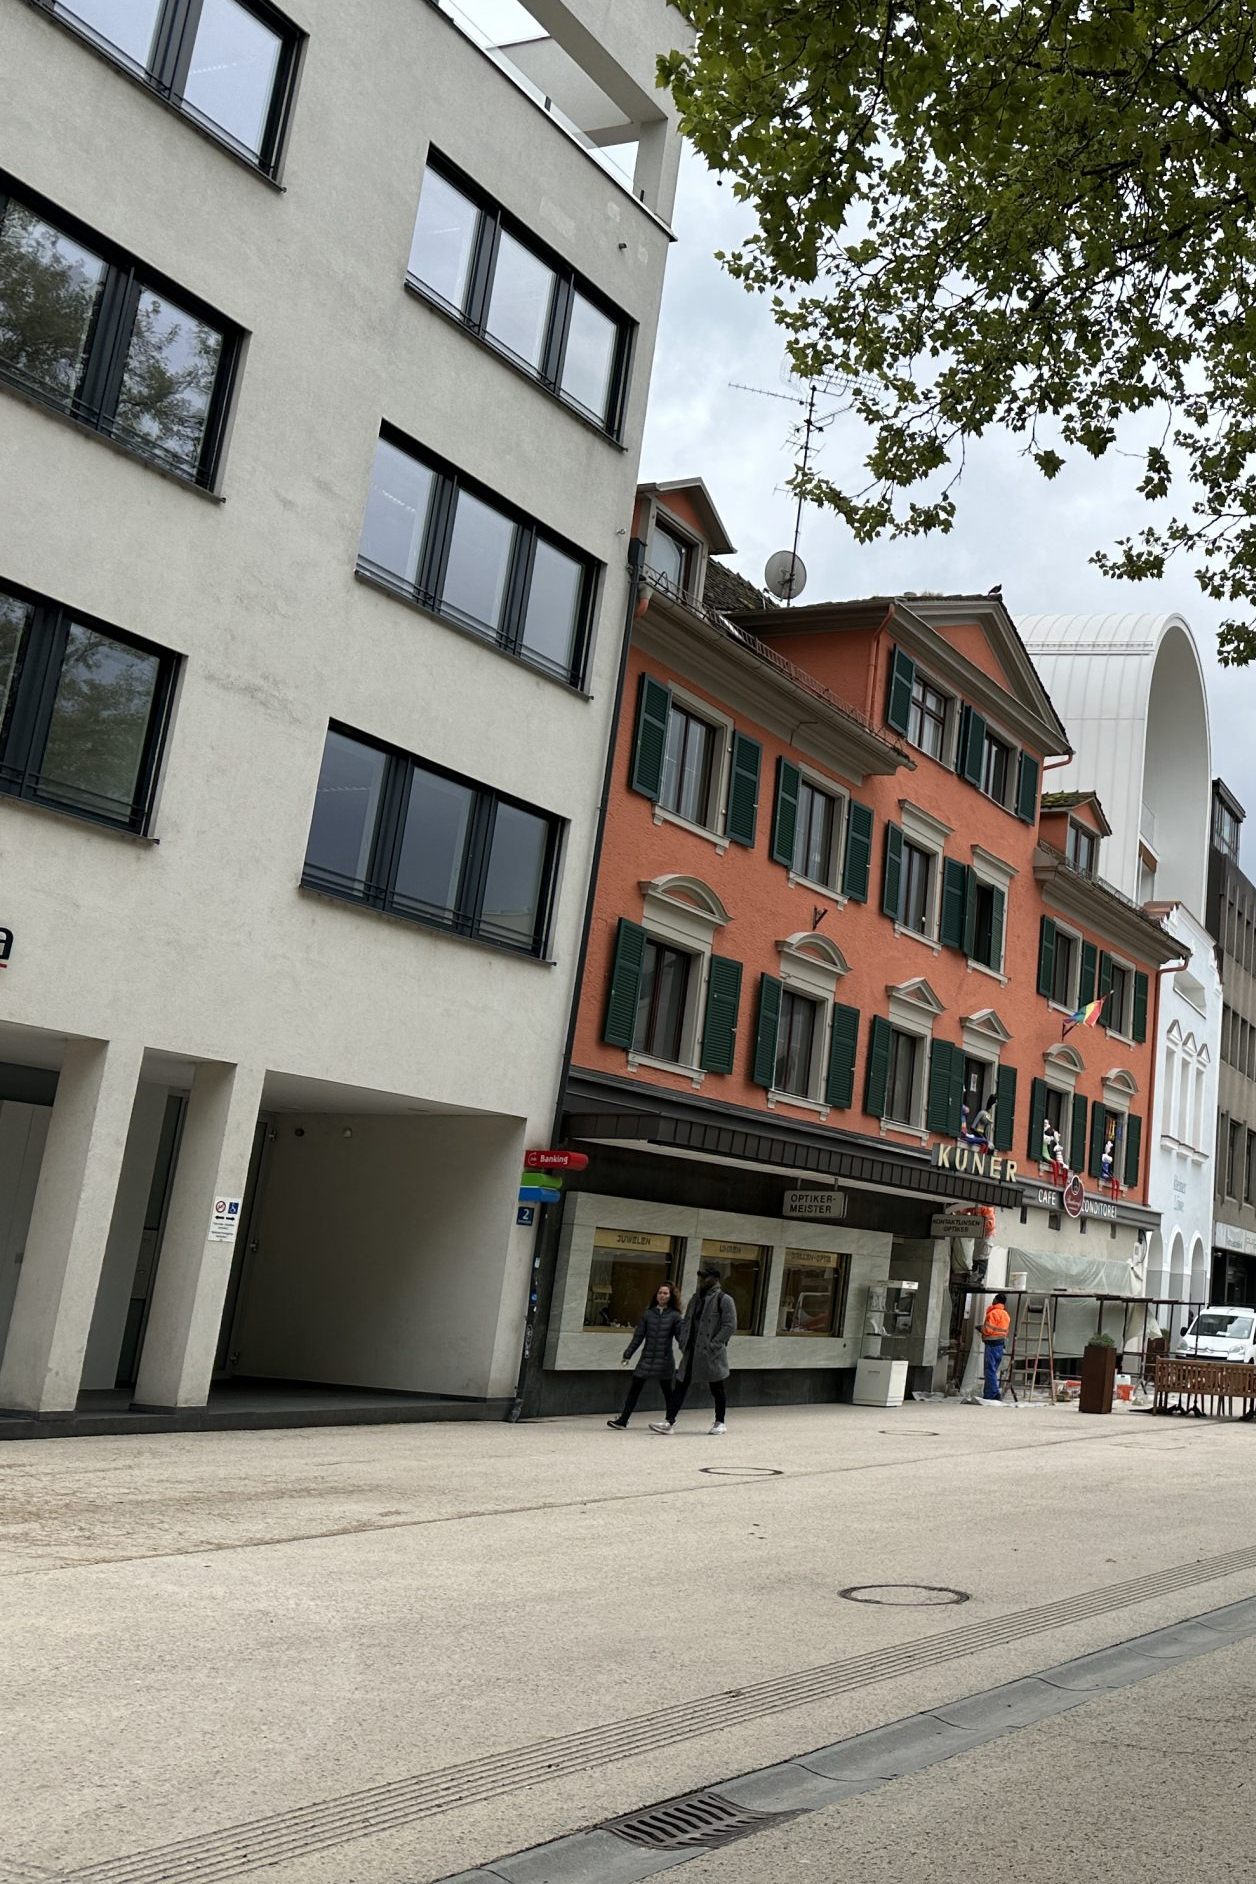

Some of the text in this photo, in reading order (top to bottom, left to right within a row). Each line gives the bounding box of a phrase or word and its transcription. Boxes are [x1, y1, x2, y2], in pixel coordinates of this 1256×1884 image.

[540, 1154, 569, 1165] Banking
[938, 1143, 1017, 1182] KUNER
[791, 1194, 836, 1204] OPTIKER-
[1038, 1189, 1057, 1206] CAFE
[522, 1208, 530, 1219] 2
[790, 1205, 831, 1214] MEISTER
[616, 1234, 651, 1246] JUWELEN
